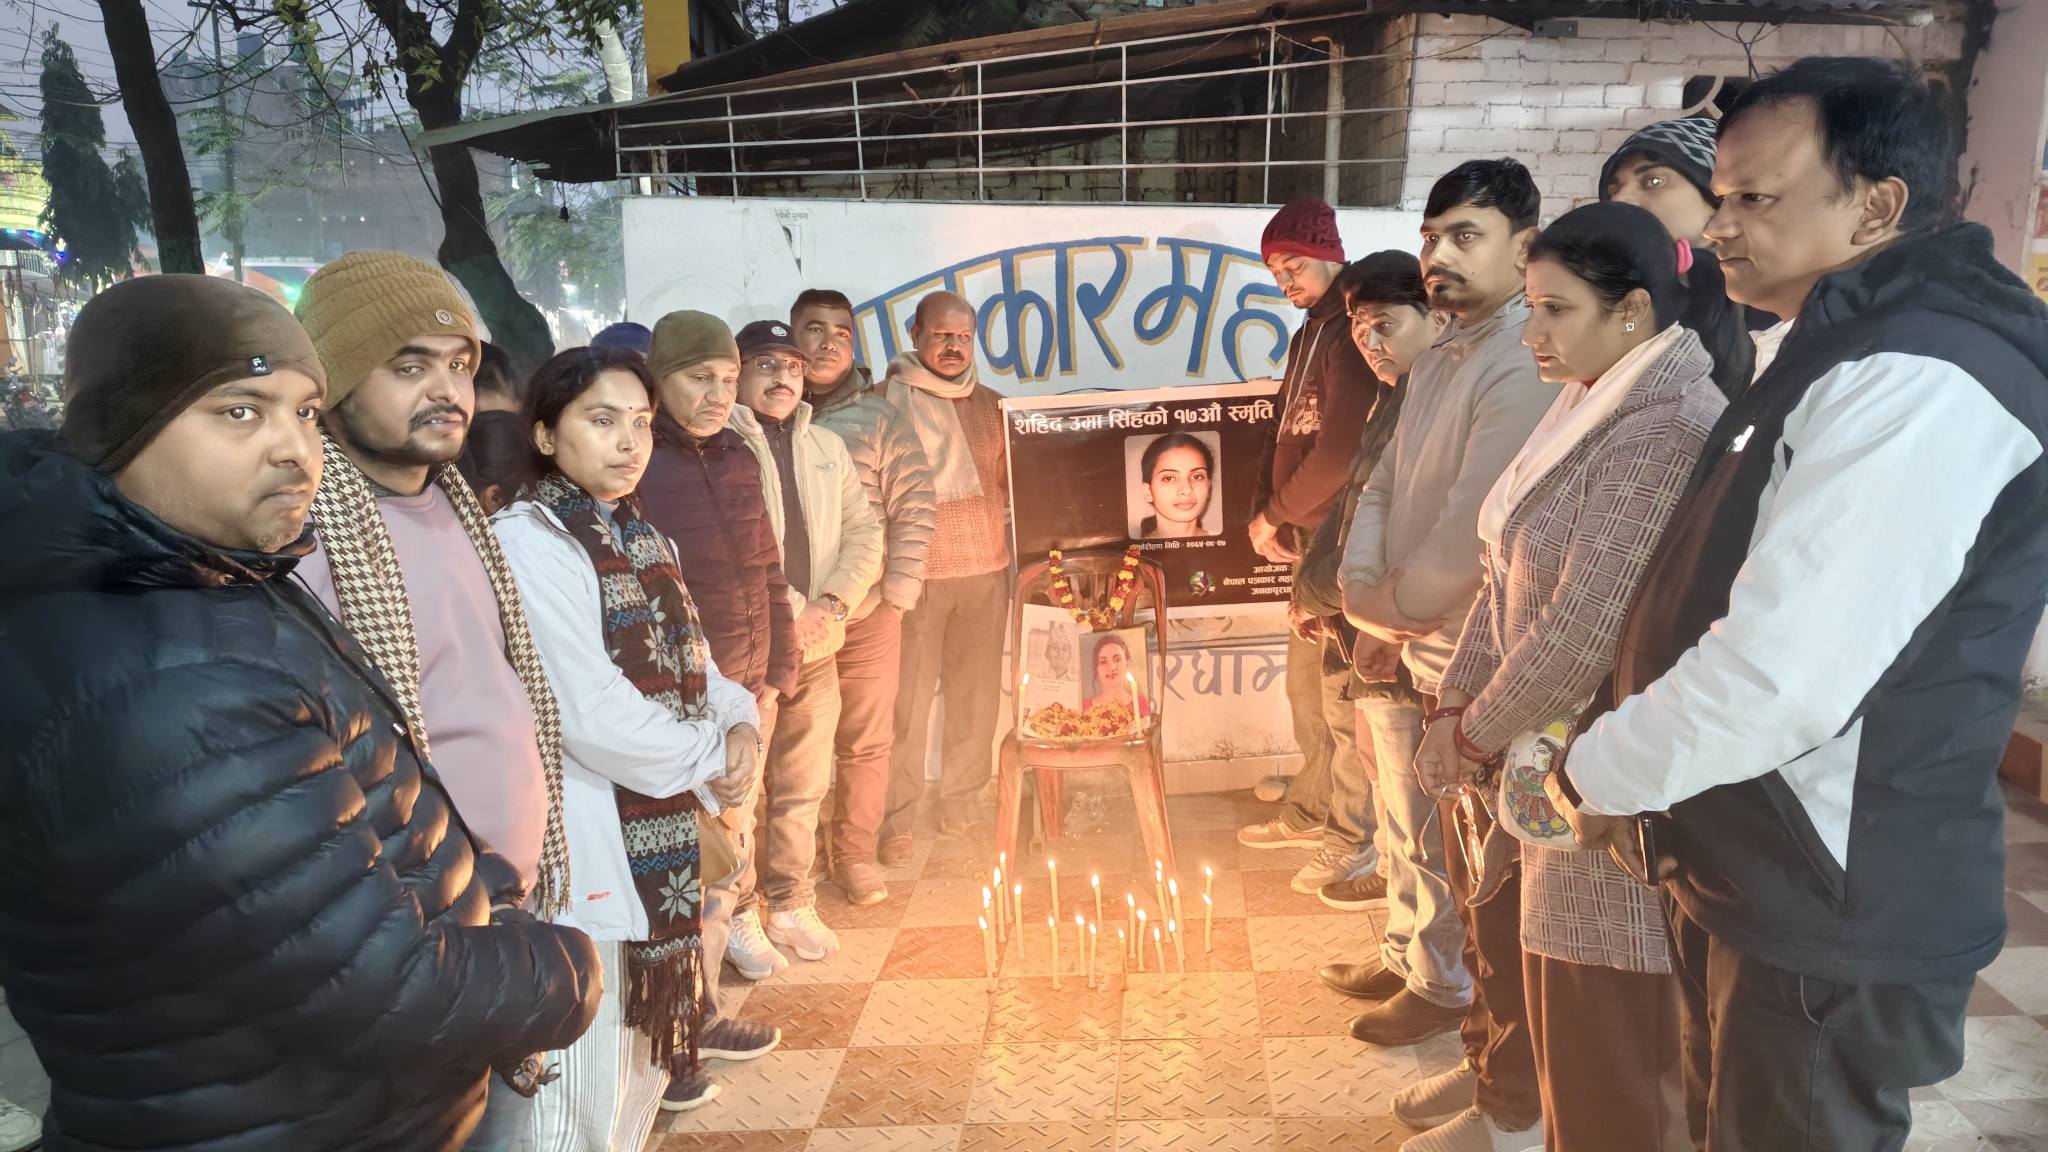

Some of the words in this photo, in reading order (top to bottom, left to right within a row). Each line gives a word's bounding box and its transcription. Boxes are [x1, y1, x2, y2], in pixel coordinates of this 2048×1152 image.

[1069, 412, 1102, 432] उमा
[1109, 405, 1169, 430] सिंहको
[1174, 402, 1222, 424] १७औं
[1227, 399, 1275, 424] स्मृति
[1223, 577, 1246, 586] नेपाल
[1247, 575, 1276, 585] पत्रकार
[1278, 575, 1293, 584] महा
